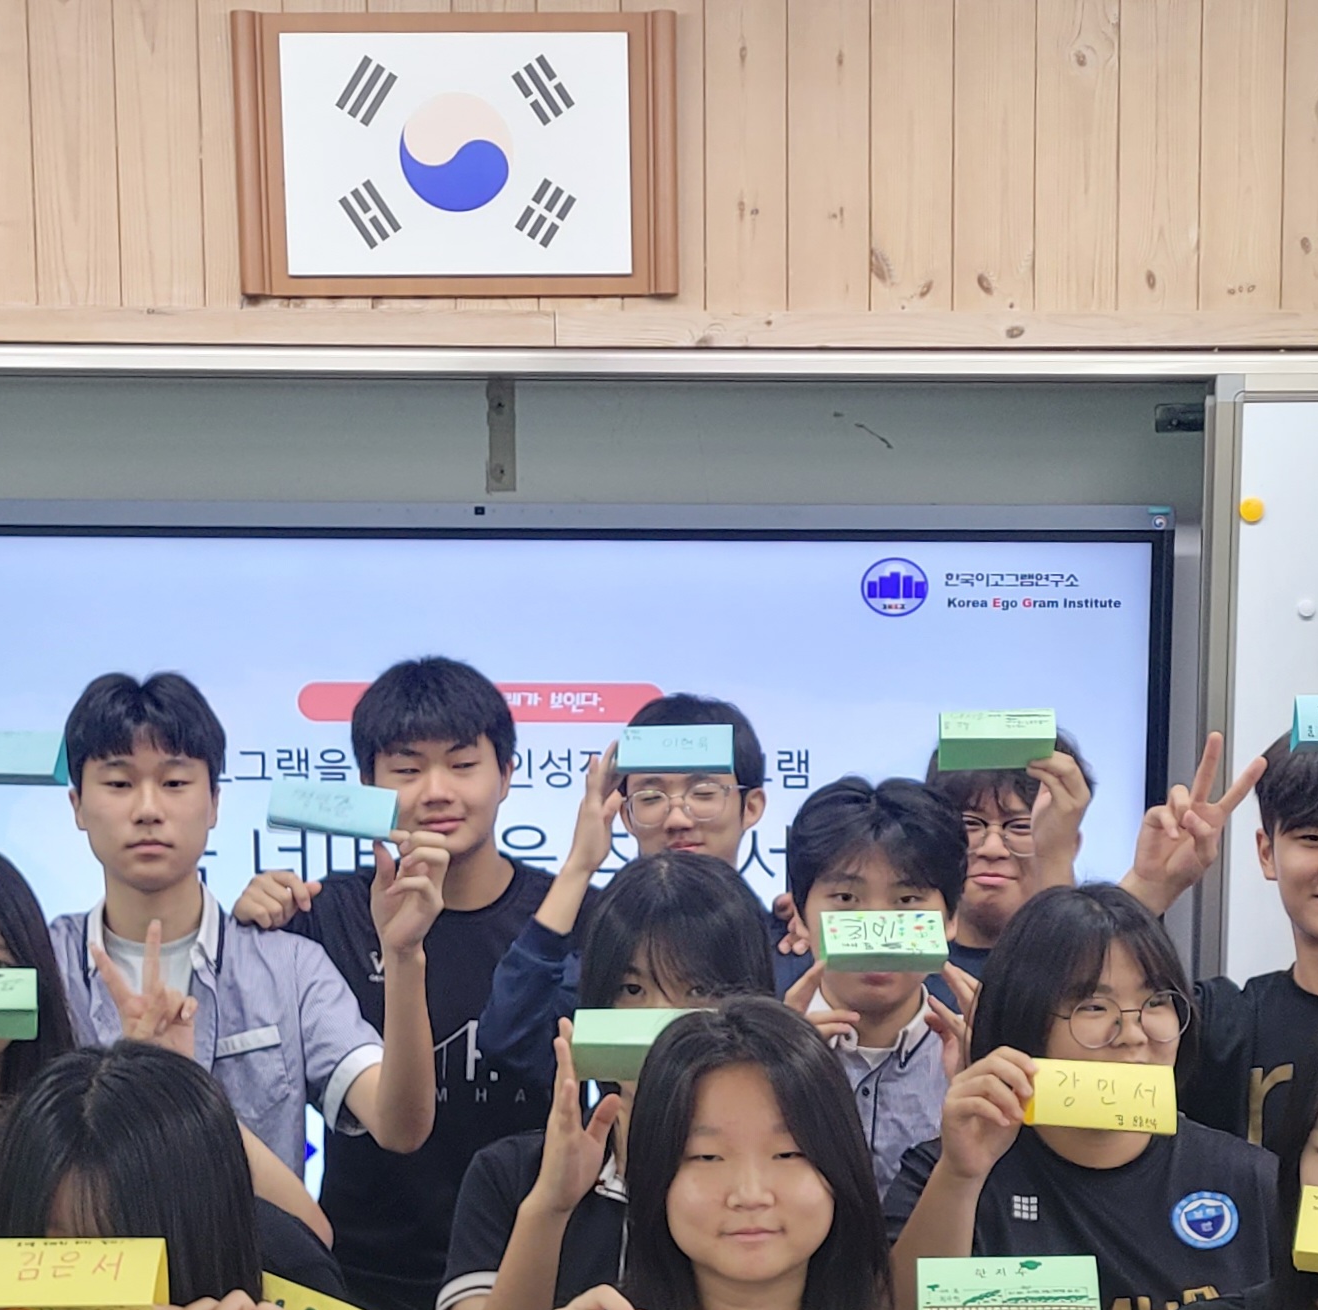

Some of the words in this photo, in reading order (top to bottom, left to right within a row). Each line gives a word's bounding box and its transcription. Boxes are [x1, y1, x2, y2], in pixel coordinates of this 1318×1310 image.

[944, 572, 1080, 588] 한국이고그램연구소
[947, 597, 988, 609] Korea
[992, 597, 1018, 611] Ego
[1022, 597, 1059, 609] Gram
[1063, 597, 1122, 609] Institute
[549, 691, 606, 713] 보인다.
[1056, 1070, 1157, 1108] 강민서
[17, 1250, 124, 1282] 김은서
